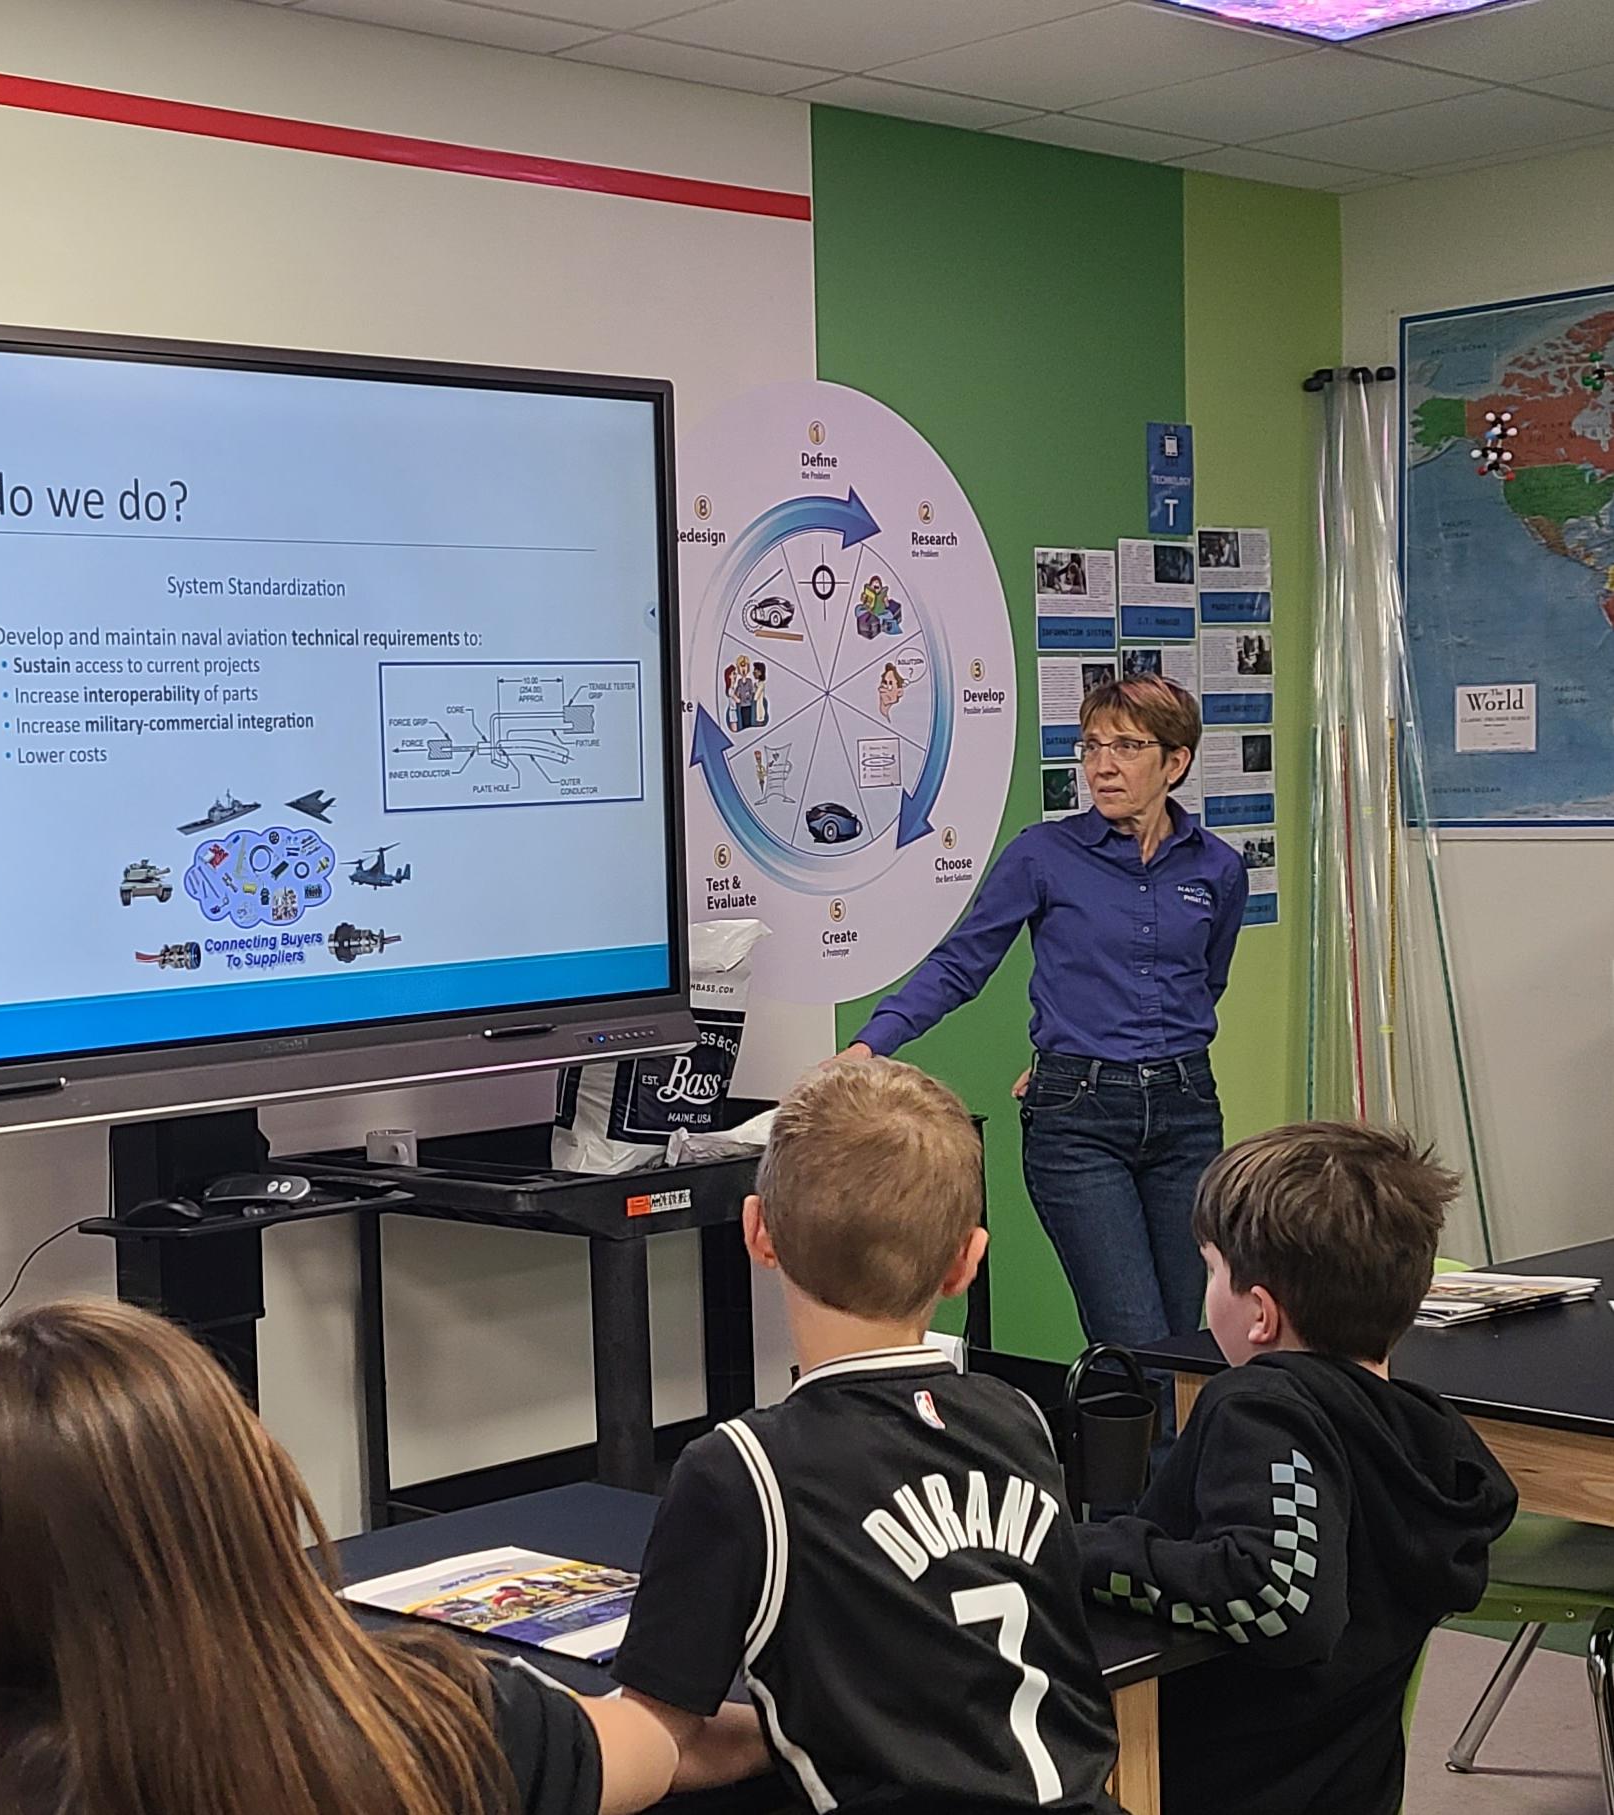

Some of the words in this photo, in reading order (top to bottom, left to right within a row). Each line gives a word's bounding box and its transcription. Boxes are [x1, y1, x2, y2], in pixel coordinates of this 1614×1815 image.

[801, 452, 837, 468] Define
[802, 471, 810, 480] the
[811, 471, 830, 480] Problem
[47, 486, 105, 520] we
[119, 478, 188, 523] do?
[1164, 498, 1179, 526] T
[911, 531, 958, 546] Research
[911, 550, 919, 558] the
[167, 576, 224, 598] System
[228, 577, 346, 597] Standardization
[69, 627, 99, 646] and
[105, 627, 176, 646] maintain
[181, 627, 222, 646] naval
[227, 628, 288, 646] aviation
[291, 629, 359, 647] technical
[363, 629, 460, 650] requirements
[464, 631, 483, 647] to:
[13, 657, 70, 674] Sustain
[75, 660, 123, 674] access
[127, 658, 143, 673] to
[146, 658, 200, 673] current
[204, 657, 261, 676] projects
[15, 687, 79, 704] Increase
[83, 685, 200, 705] interoperability
[204, 685, 219, 701] of
[222, 687, 258, 704] parts
[963, 688, 1005, 704] Develop
[1466, 688, 1524, 711] World
[446, 705, 465, 714] CORE
[16, 717, 81, 734] Increase
[85, 713, 233, 735] military-commercial
[237, 712, 314, 731] integration
[388, 718, 411, 727] FORCE
[402, 739, 423, 748] FORCE
[575, 739, 600, 748] FIXTURE
[17, 748, 65, 764] Lower
[69, 747, 107, 763] costs
[389, 771, 408, 779] INNER
[410, 770, 450, 779] CONDUCTOR
[472, 784, 492, 793] PLATE
[493, 783, 510, 792] HOLE
[935, 857, 973, 871] Choose
[706, 877, 729, 892] Test
[732, 875, 741, 889] &
[707, 893, 757, 910] Evaluate
[205, 934, 279, 953] Connecting
[281, 930, 323, 950] Buyers
[822, 930, 858, 945] Create
[226, 953, 241, 968] To
[243, 949, 304, 968] Suppliers
[642, 1074, 659, 1087] EST.
[657, 1055, 722, 1105] Bass
[862, 1470, 1059, 1582] DURANT
[950, 1582, 1063, 1805] 7
